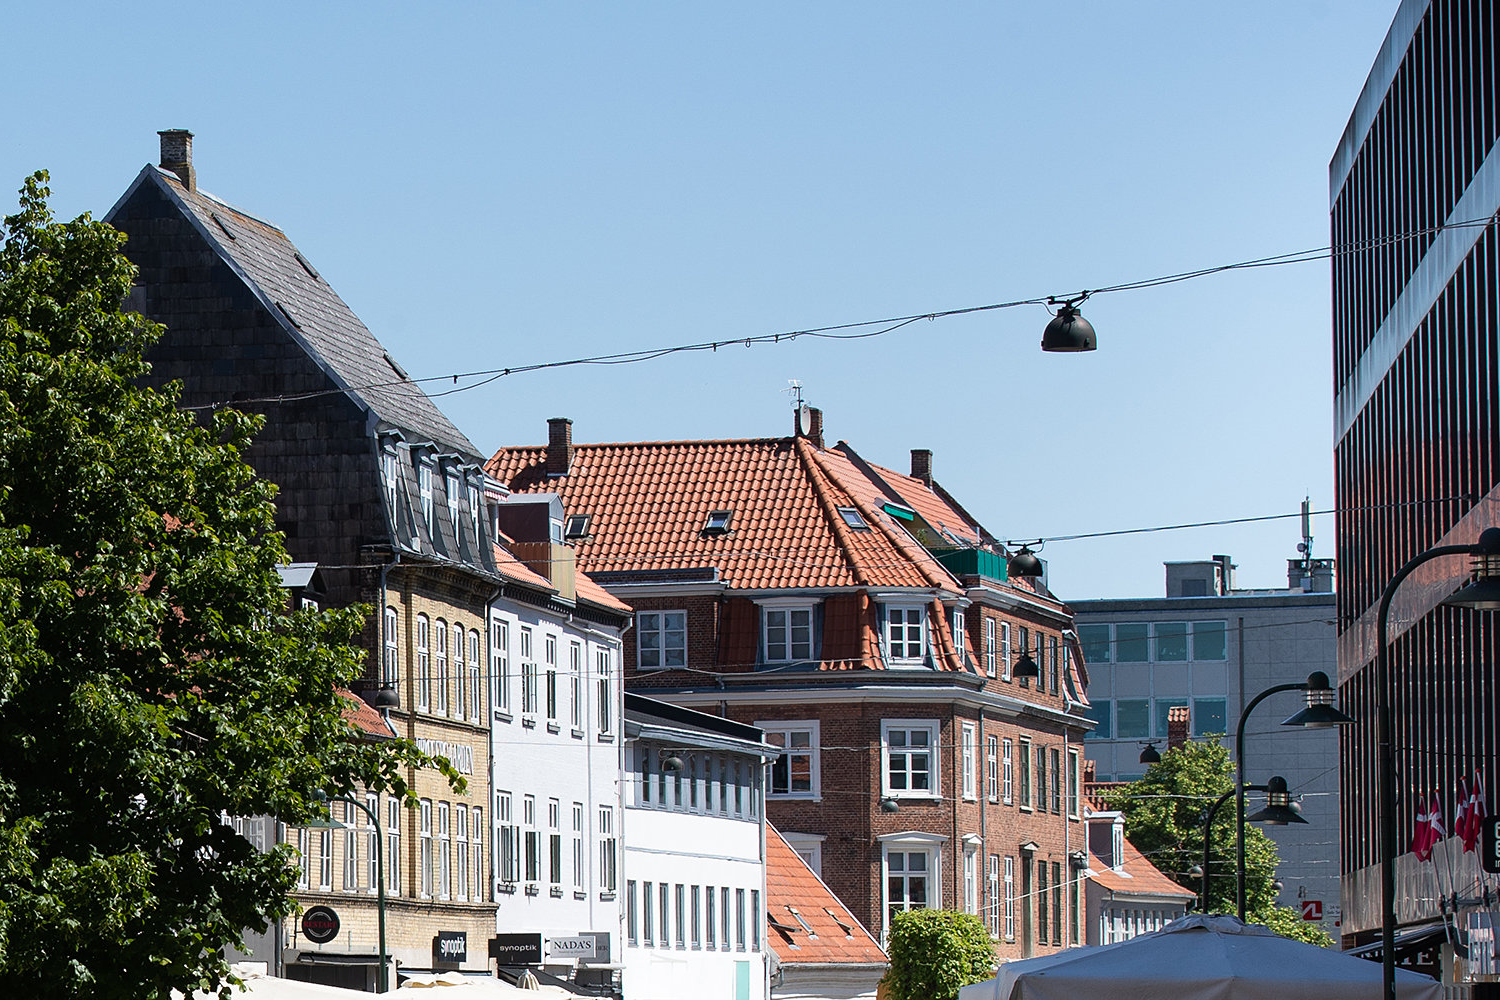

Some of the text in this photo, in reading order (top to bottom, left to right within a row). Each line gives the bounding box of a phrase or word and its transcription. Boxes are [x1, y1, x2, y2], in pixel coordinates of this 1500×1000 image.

[440, 936, 466, 958] synoptik
[499, 943, 538, 952] synoptik
[553, 940, 592, 950] NADA'S
